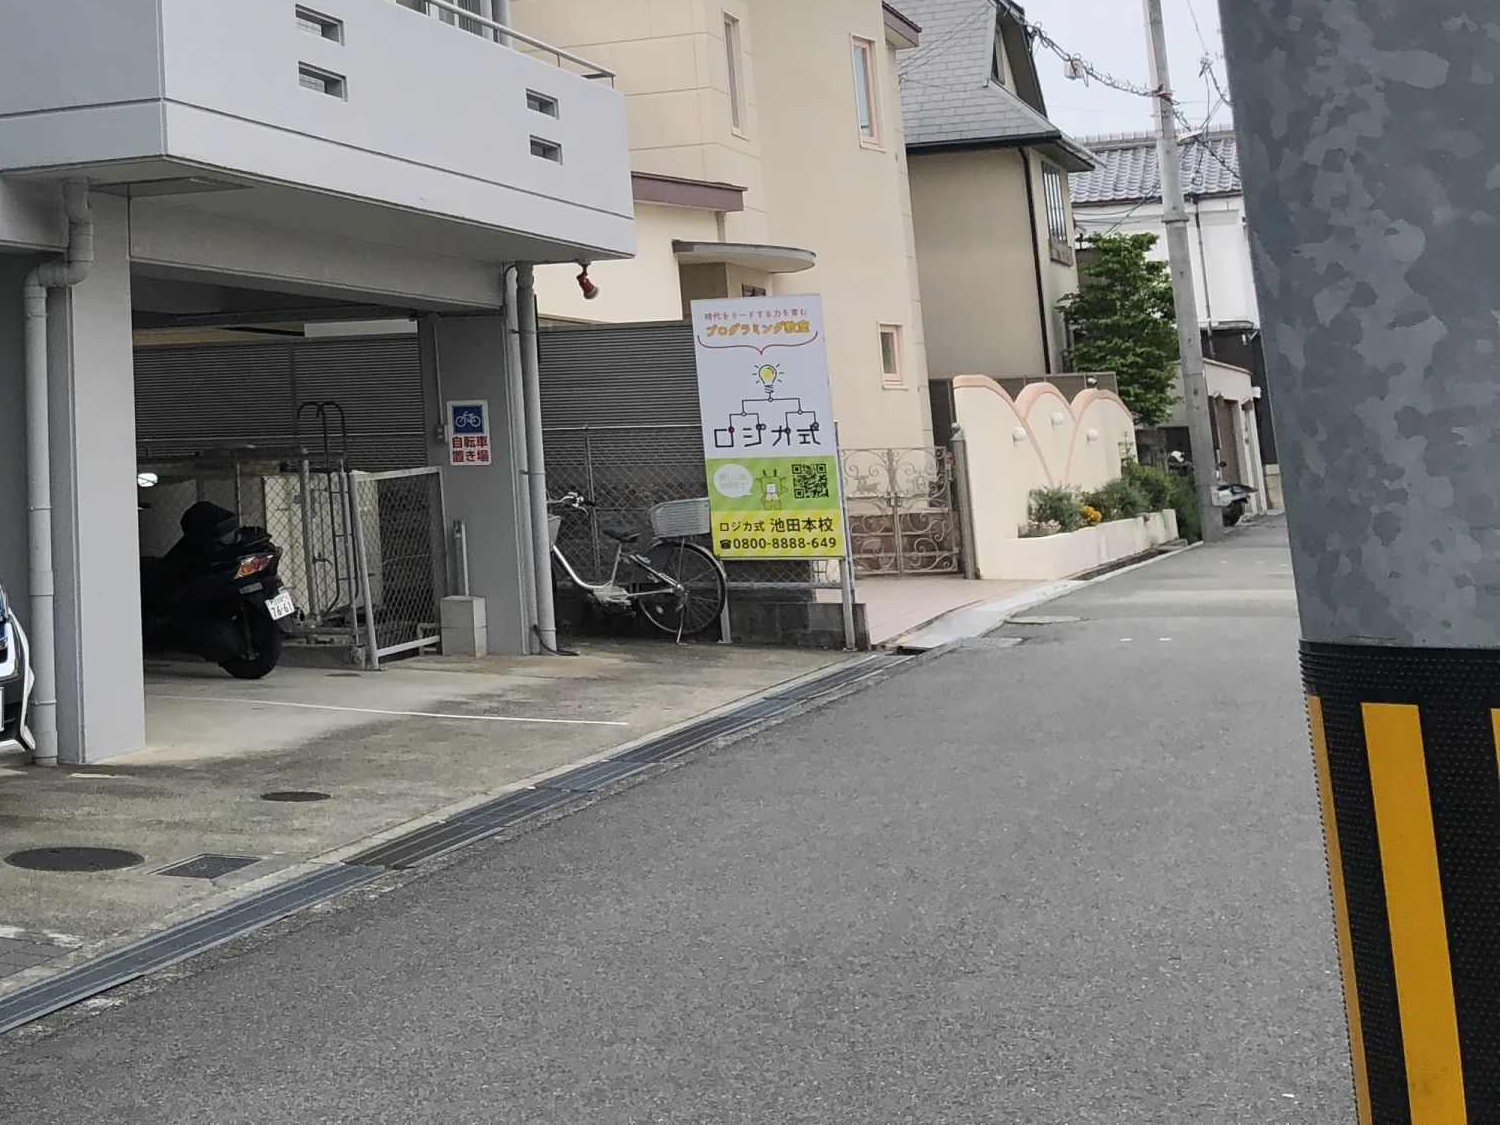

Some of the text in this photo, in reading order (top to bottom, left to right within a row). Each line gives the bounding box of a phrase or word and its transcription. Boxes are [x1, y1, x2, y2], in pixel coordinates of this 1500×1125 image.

[706, 320, 810, 337] プログラミング教室
[452, 436, 488, 448] 自転車
[453, 449, 489, 463] 置き場
[719, 518, 834, 533] ロジカ式 池田本校
